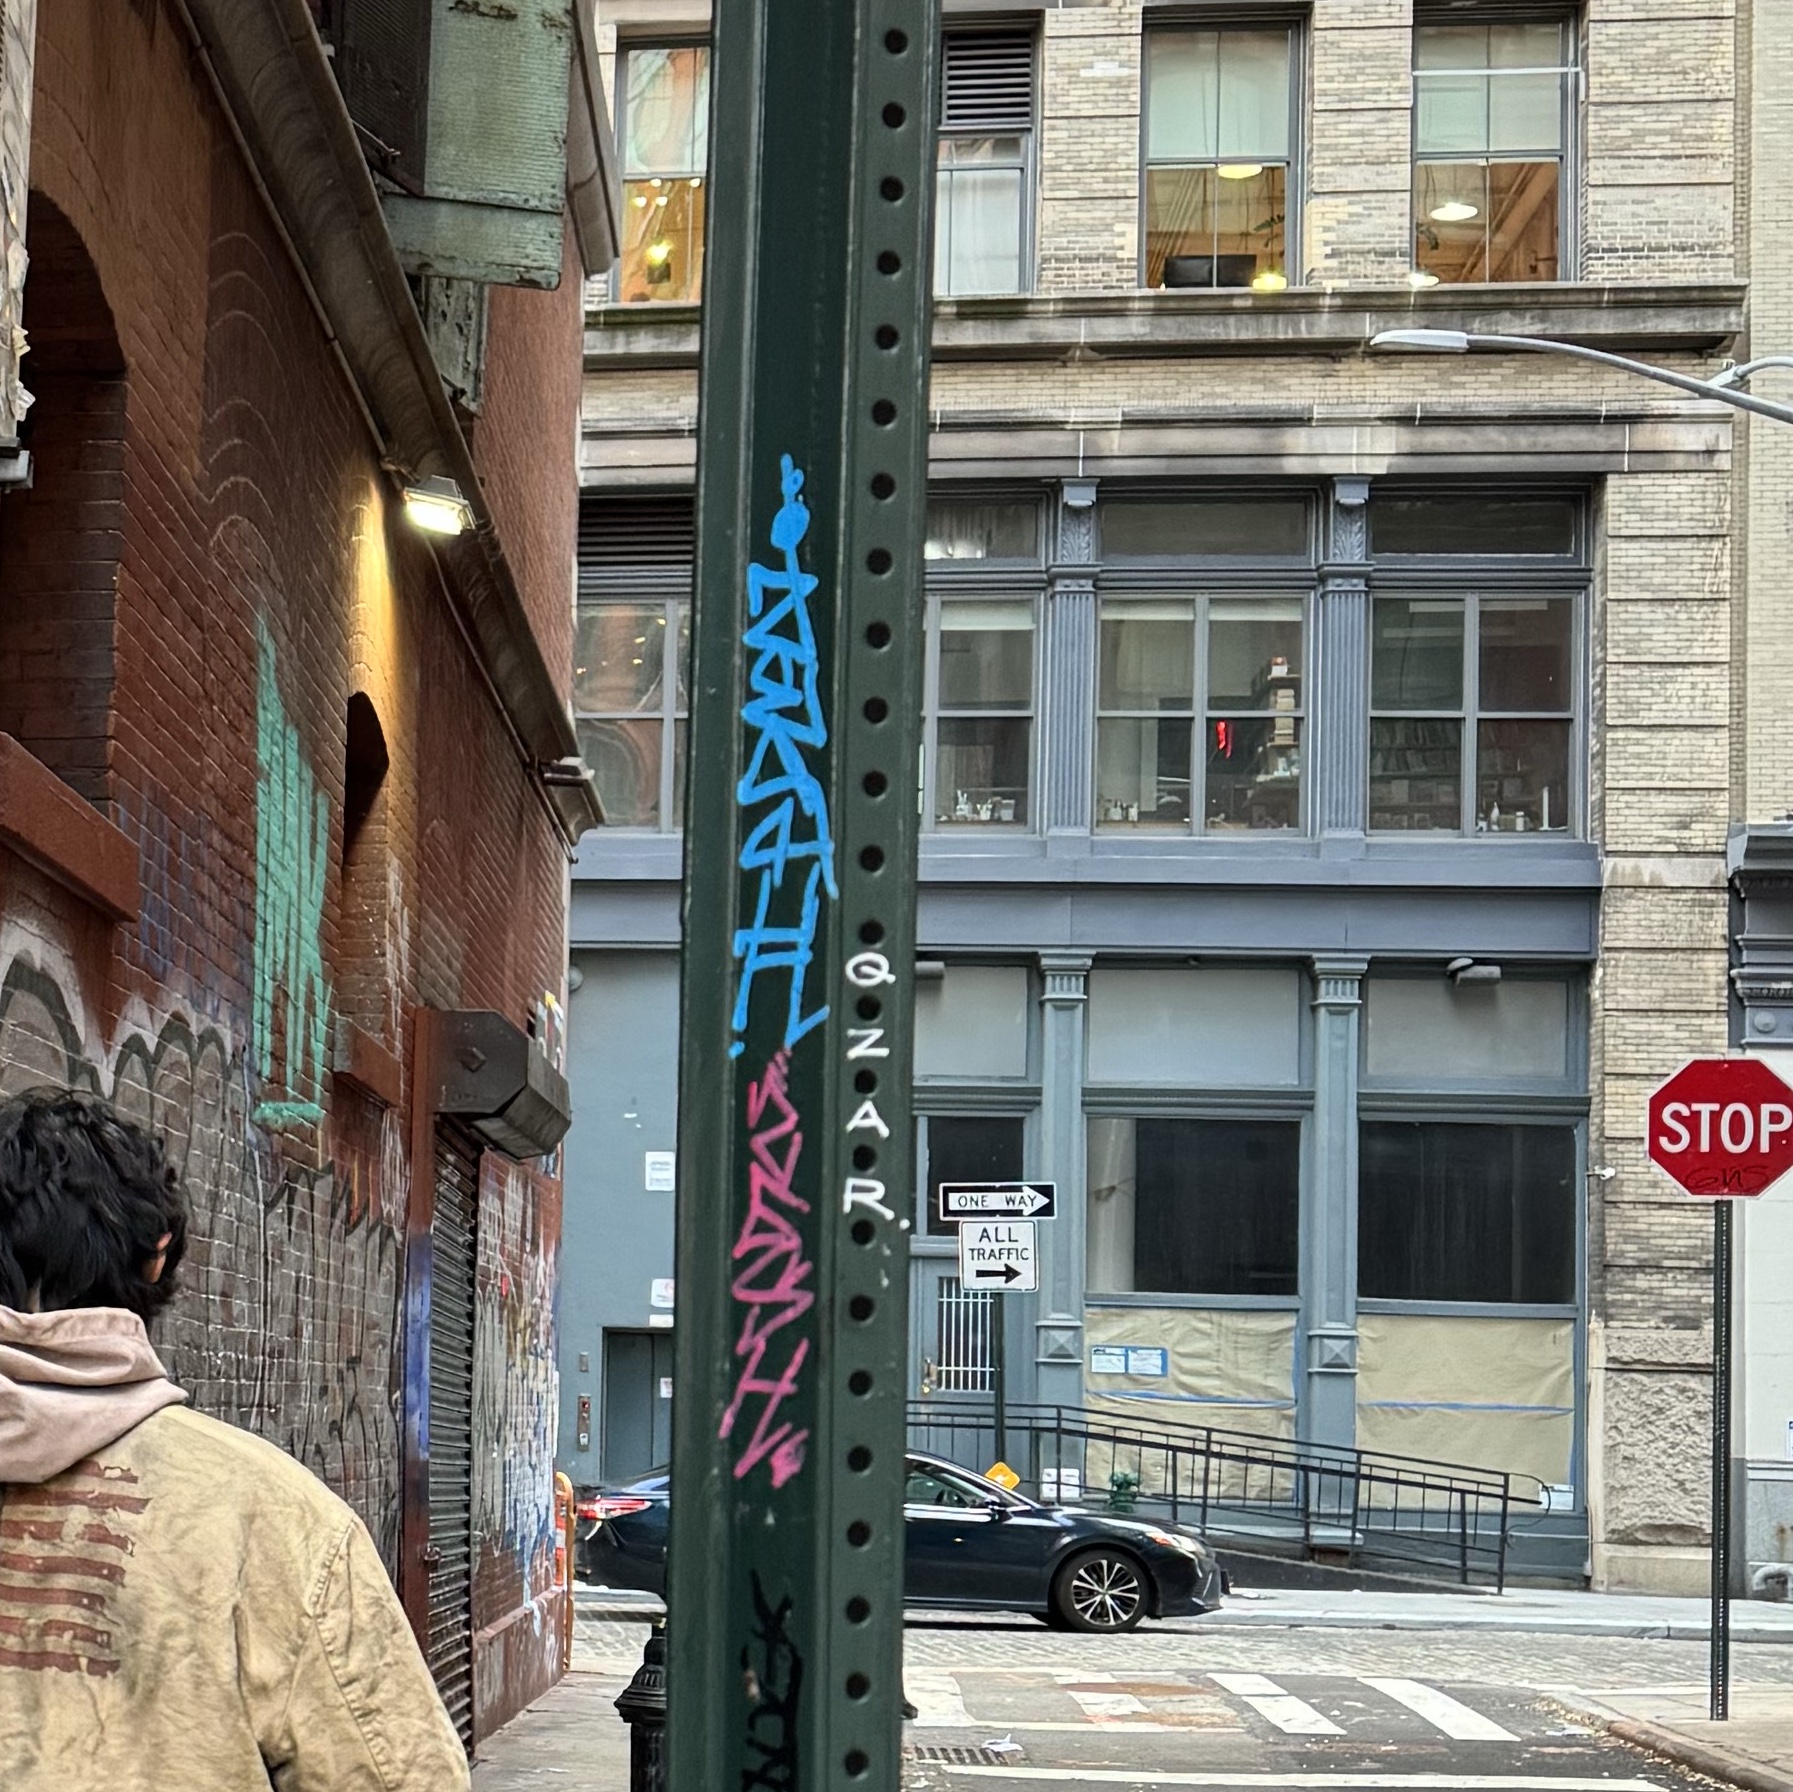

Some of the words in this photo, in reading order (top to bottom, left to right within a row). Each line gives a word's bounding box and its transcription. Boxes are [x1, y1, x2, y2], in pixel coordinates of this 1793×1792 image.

[1658, 1101, 1793, 1154] STOP
[957, 1194, 989, 1208] ONE
[1004, 1194, 1037, 1208] WAY
[978, 1226, 1019, 1243] ALL
[968, 1247, 1030, 1261] TRAFFIC
